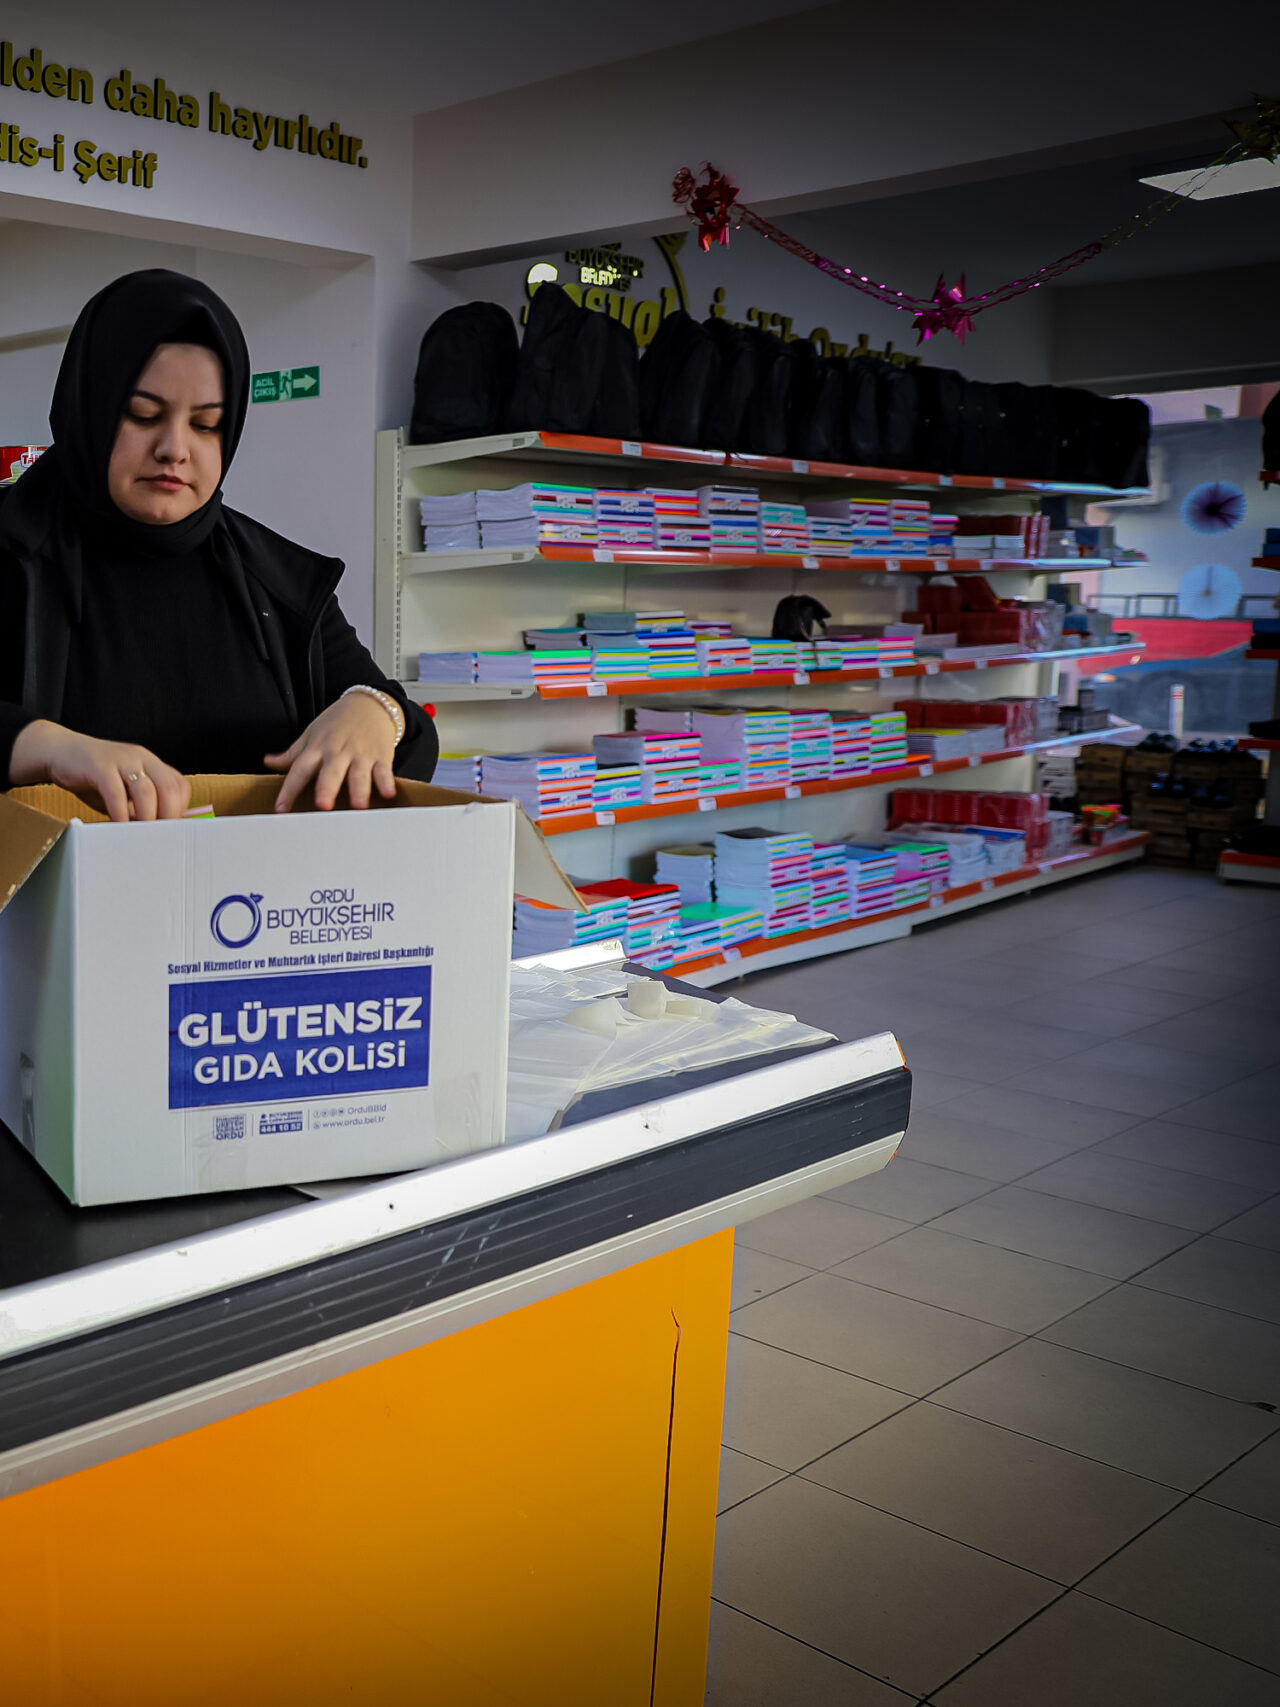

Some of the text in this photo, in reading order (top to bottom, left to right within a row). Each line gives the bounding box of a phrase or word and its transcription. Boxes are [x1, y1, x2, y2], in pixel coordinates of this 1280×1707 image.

[104, 69, 200, 129] daha
[209, 91, 369, 168] hayırlıdır.
[74, 140, 158, 188] Şerif
[310, 888, 355, 904] ORDU
[267, 902, 395, 929] BÜYÜKŞEHİR
[290, 925, 373, 945] BELEDİYESİ
[168, 961, 201, 975] Sosyal
[203, 957, 252, 972] Hizmetler
[254, 958, 266, 969] ve
[268, 953, 316, 967] Muhtarlık
[346, 949, 380, 963] Dairesi
[383, 945, 434, 962] Başkanlığı
[194, 1051, 284, 1085] GIDA
[216, 1132, 244, 1140] ORDU
